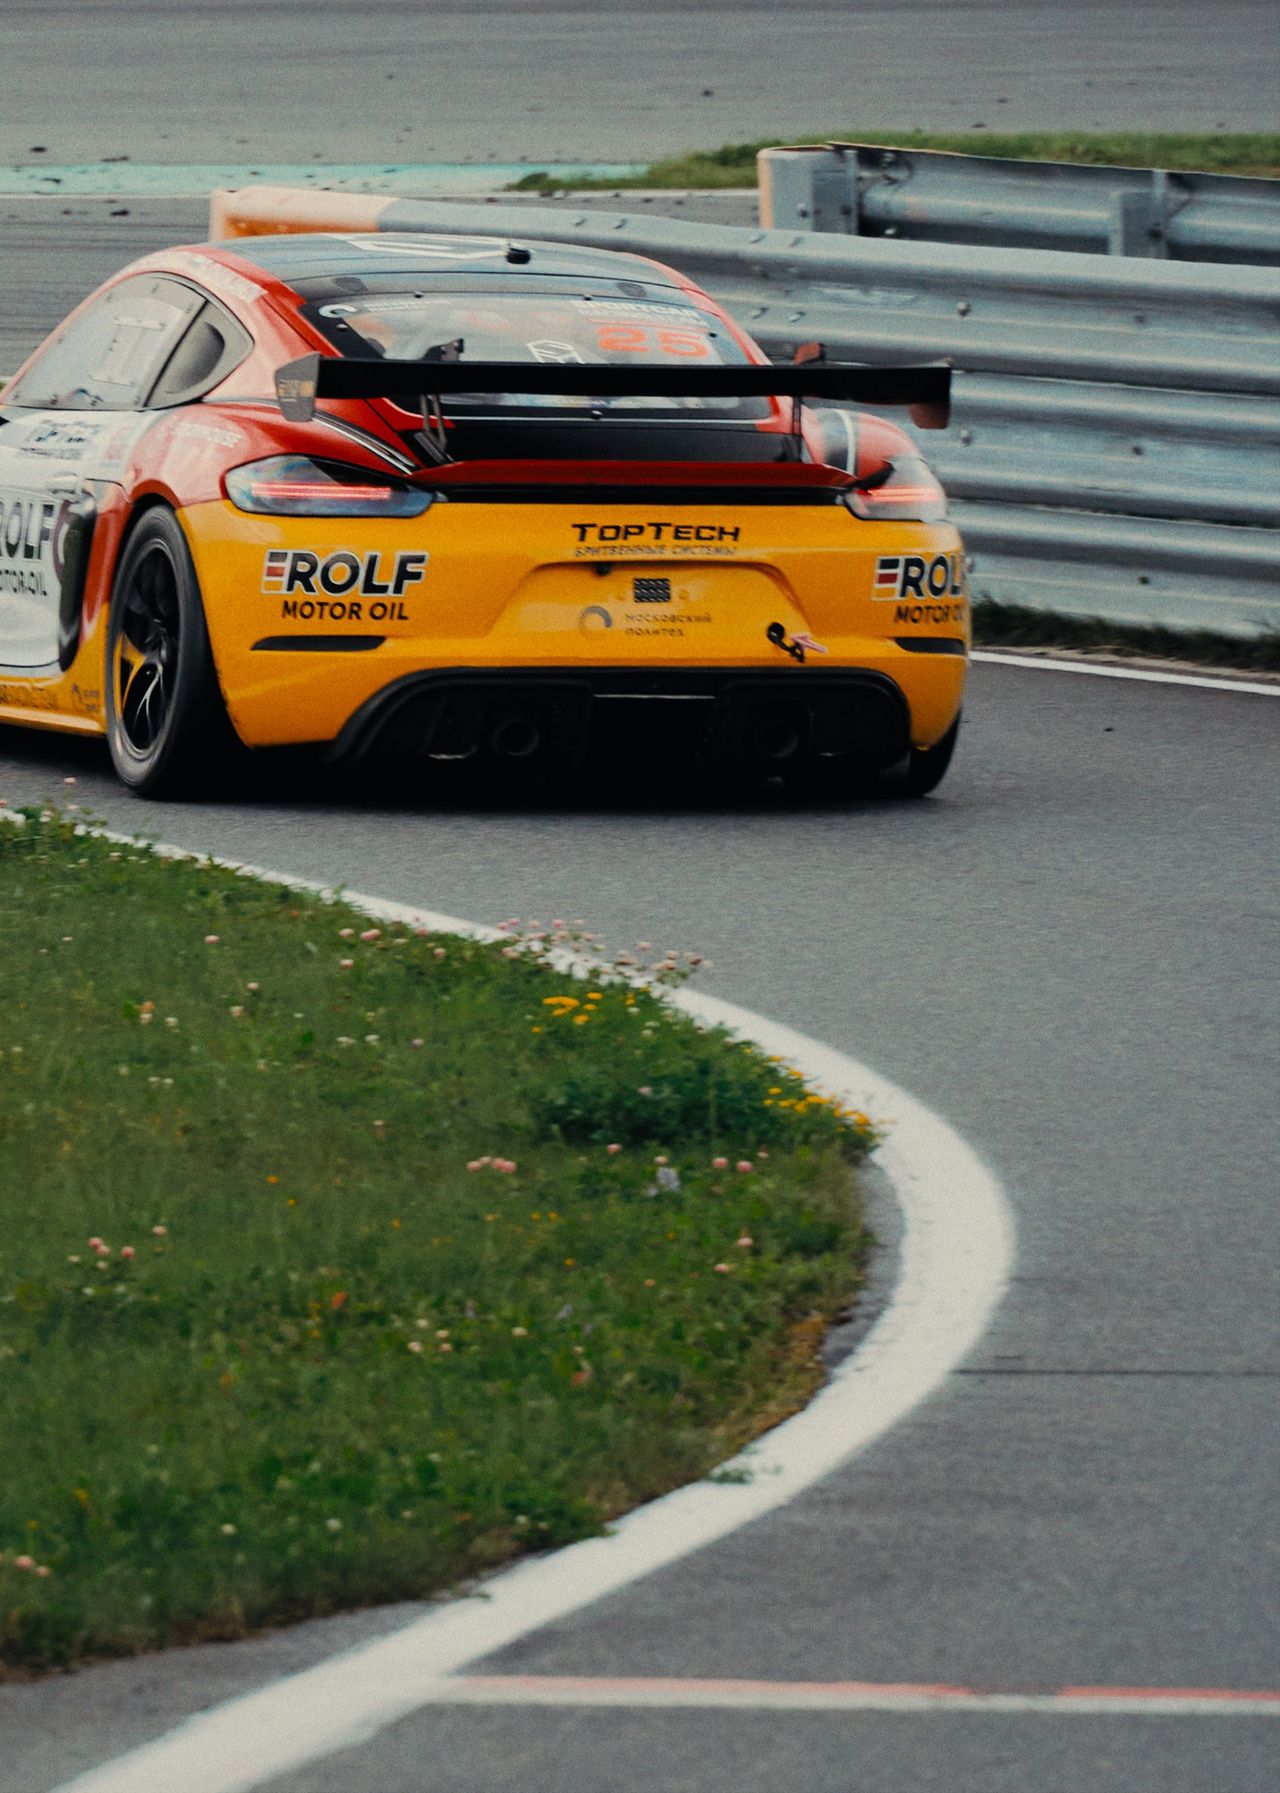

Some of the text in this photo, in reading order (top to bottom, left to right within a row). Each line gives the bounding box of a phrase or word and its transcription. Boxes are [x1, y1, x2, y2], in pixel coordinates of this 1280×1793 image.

[596, 326, 710, 358] 25
[672, 545, 737, 556] СИСТЕМЫ
[286, 551, 428, 595] ROLF
[899, 554, 966, 599] ROL
[282, 600, 409, 620] MOTOR OIL
